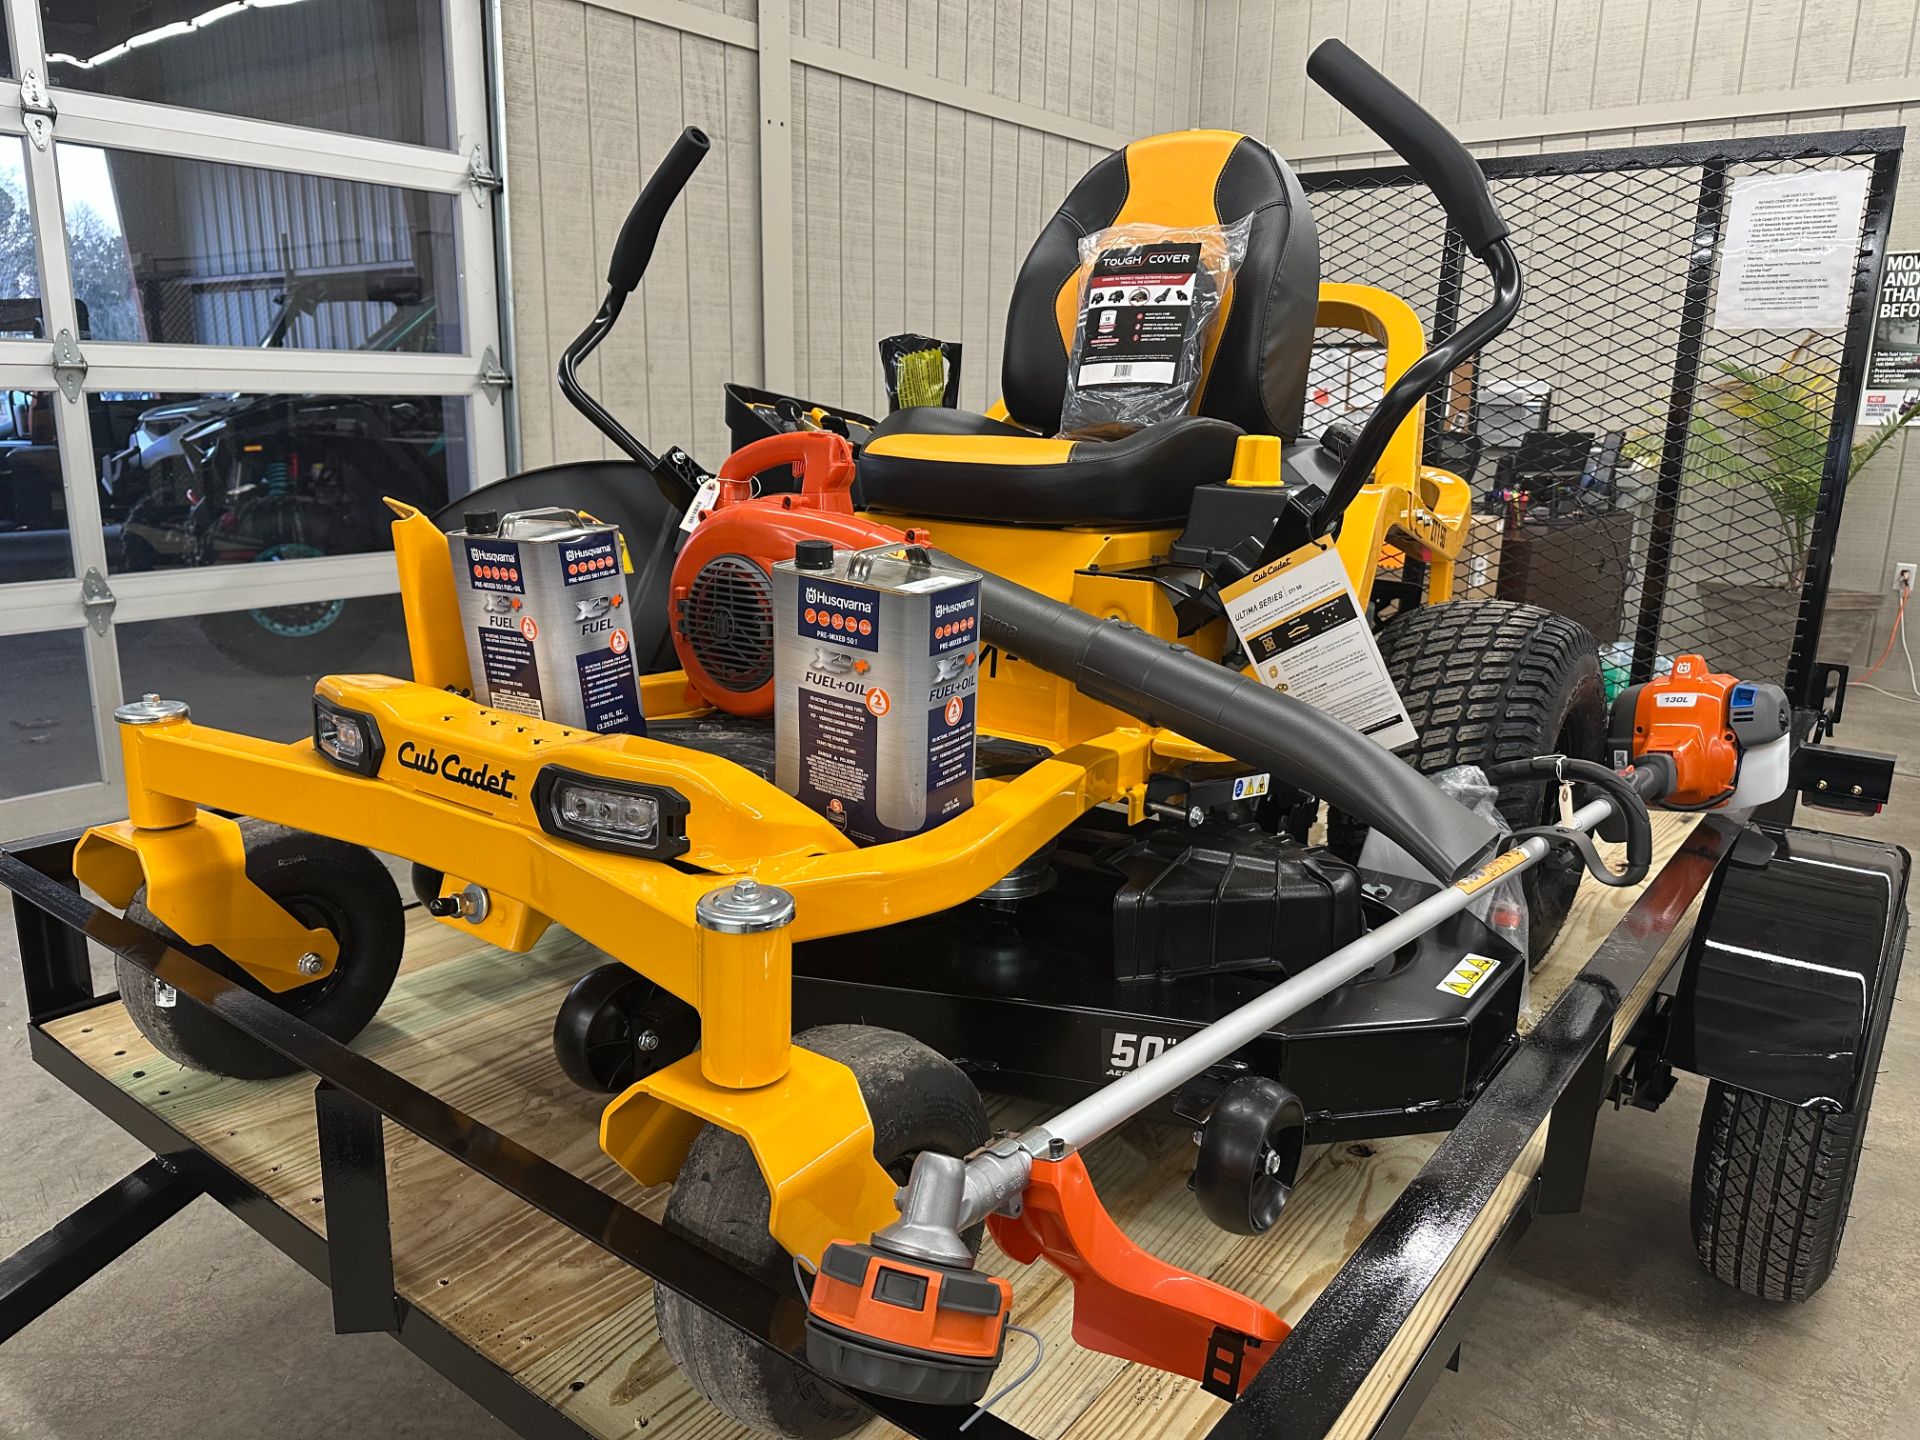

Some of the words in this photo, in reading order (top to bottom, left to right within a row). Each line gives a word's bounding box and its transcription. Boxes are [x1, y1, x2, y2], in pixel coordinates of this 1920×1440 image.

[1103, 256, 1142, 267] TOUGH
[1149, 254, 1190, 264] COVER
[1884, 272, 1920, 287] AND
[1880, 303, 1920, 318] BEFO
[478, 550, 515, 563] Husqvarna
[575, 545, 611, 559] Husqvarna
[1252, 571, 1267, 582] Cub
[1267, 558, 1292, 575] Cadet
[569, 575, 591, 583] PRE-MIXED
[817, 592, 872, 613] Husqvarna
[943, 598, 975, 615] Husqvarna
[1235, 604, 1258, 621] ULTIMA
[1258, 591, 1283, 609] SERIES
[490, 616, 514, 629] FUEL
[582, 618, 614, 635] FUEL
[816, 630, 845, 643] PRE-MIXED
[846, 636, 858, 645] 50:1
[940, 638, 962, 650] PRE-MIXED
[805, 671, 867, 696] FUEL+OIL
[929, 675, 975, 702] FUEL+OIL
[874, 694, 882, 706] 2
[398, 741, 438, 775] Cub
[441, 754, 516, 799] Cadet
[1110, 1032, 1177, 1068] 50"
